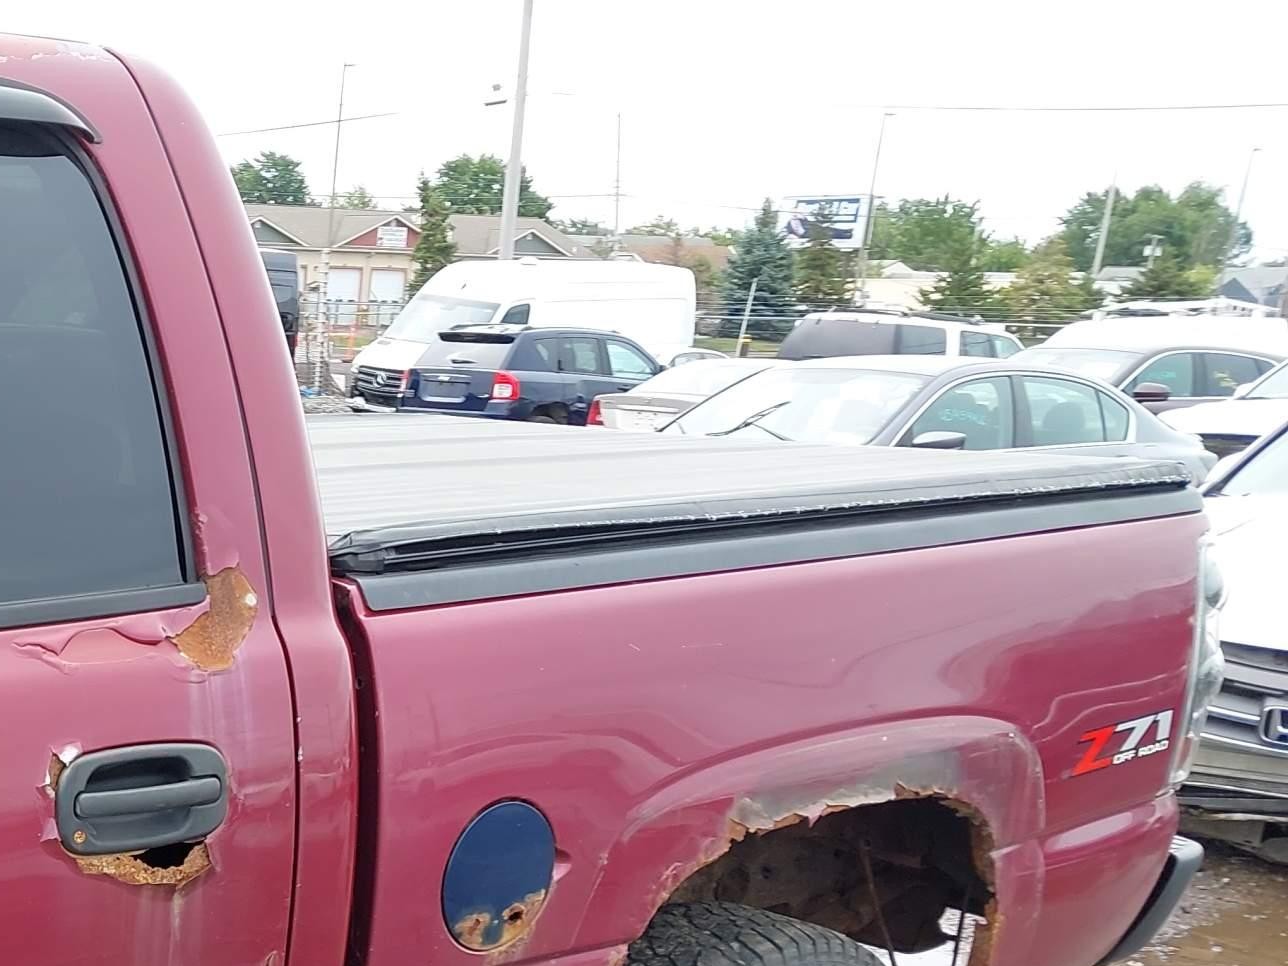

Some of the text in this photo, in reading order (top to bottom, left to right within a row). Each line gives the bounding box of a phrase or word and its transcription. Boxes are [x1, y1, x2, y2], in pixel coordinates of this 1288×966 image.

[1072, 709, 1174, 776] Z71
[1112, 740, 1169, 765] OFF ROAD
